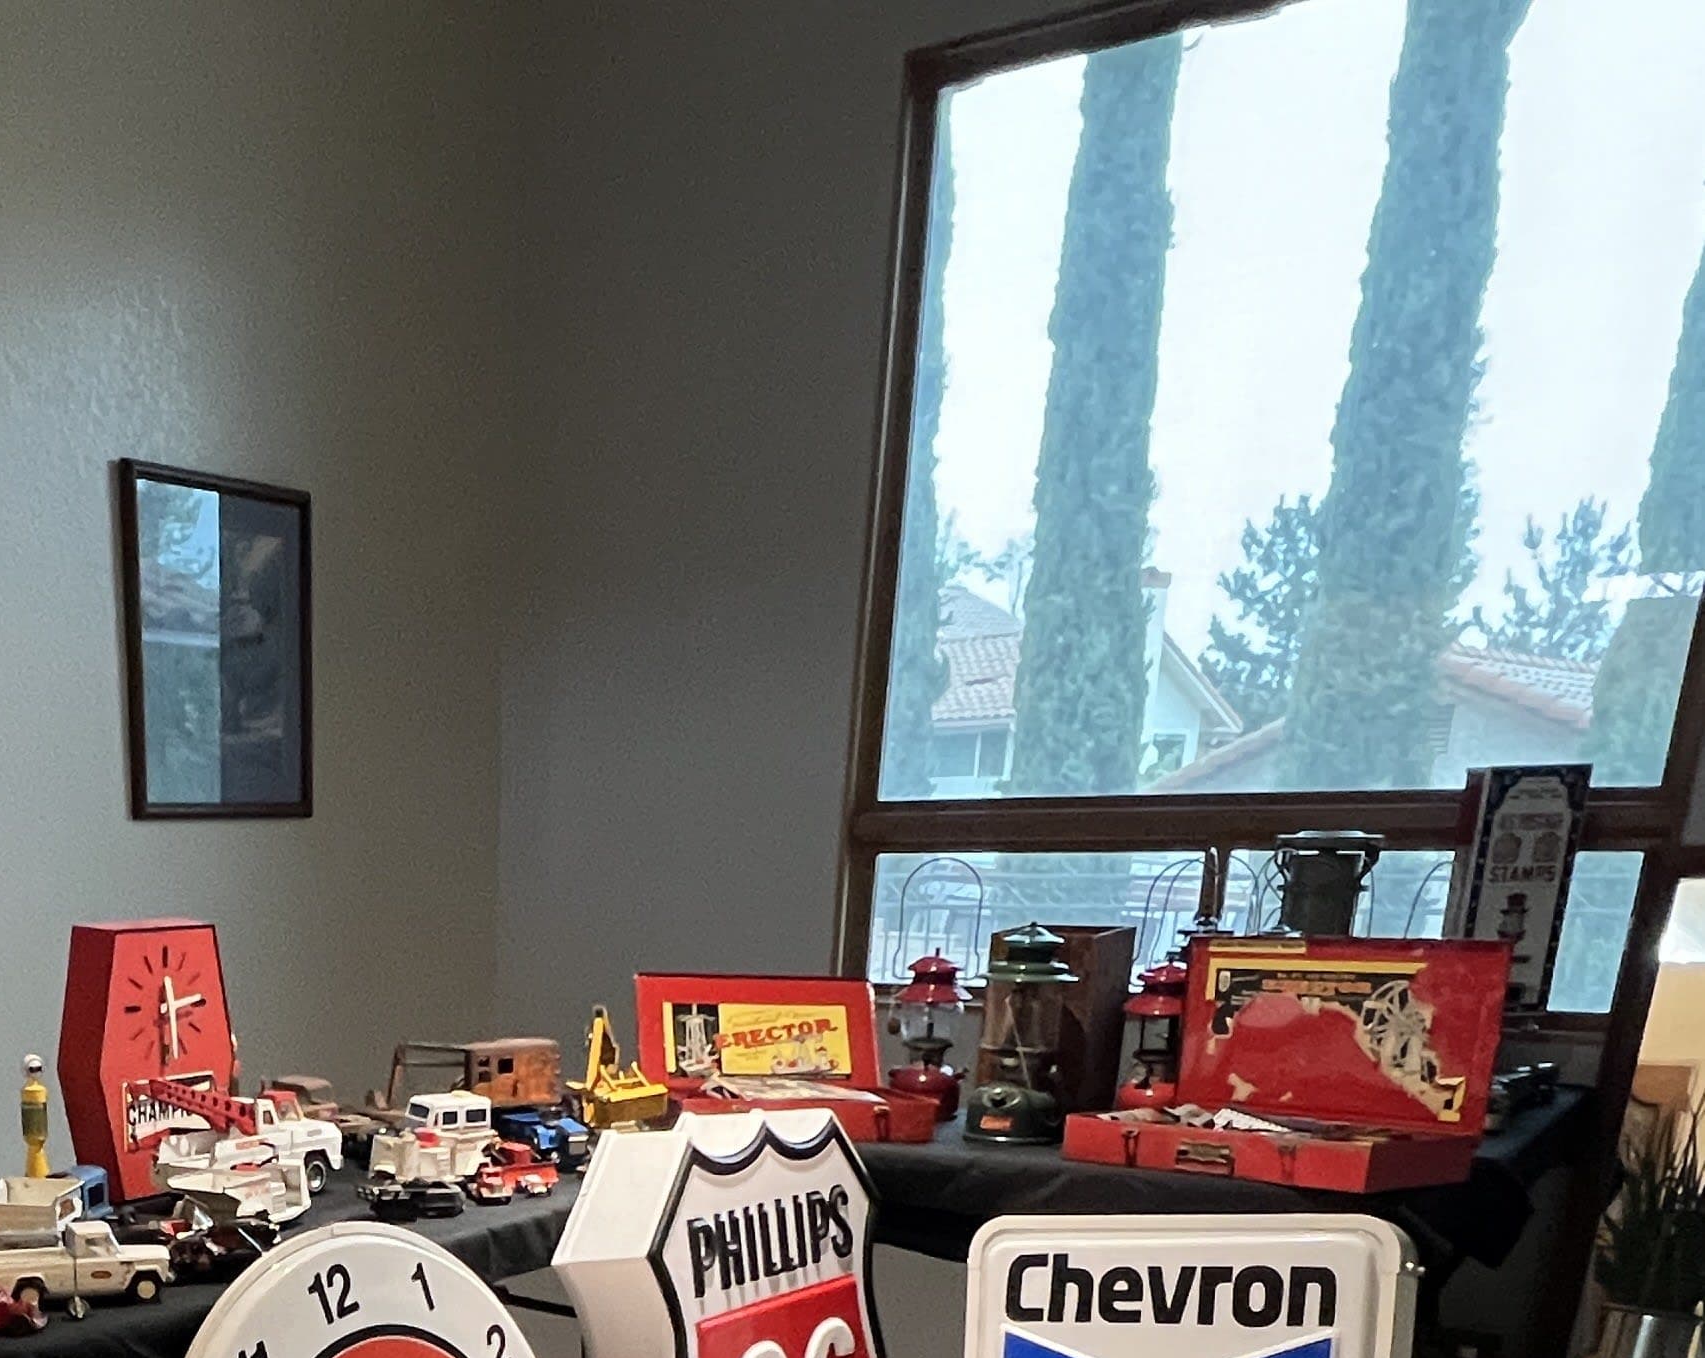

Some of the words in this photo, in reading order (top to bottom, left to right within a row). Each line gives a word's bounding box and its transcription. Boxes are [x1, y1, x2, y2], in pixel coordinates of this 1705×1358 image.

[1489, 865, 1556, 883] STAMPS
[714, 1018, 839, 1049] ERECTOR
[127, 1098, 194, 1127] CHAMPI
[686, 1184, 854, 1299] PHILLIPS
[308, 1264, 359, 1324] 12
[412, 1263, 435, 1310] 1
[1005, 1253, 1337, 1328] Chevron
